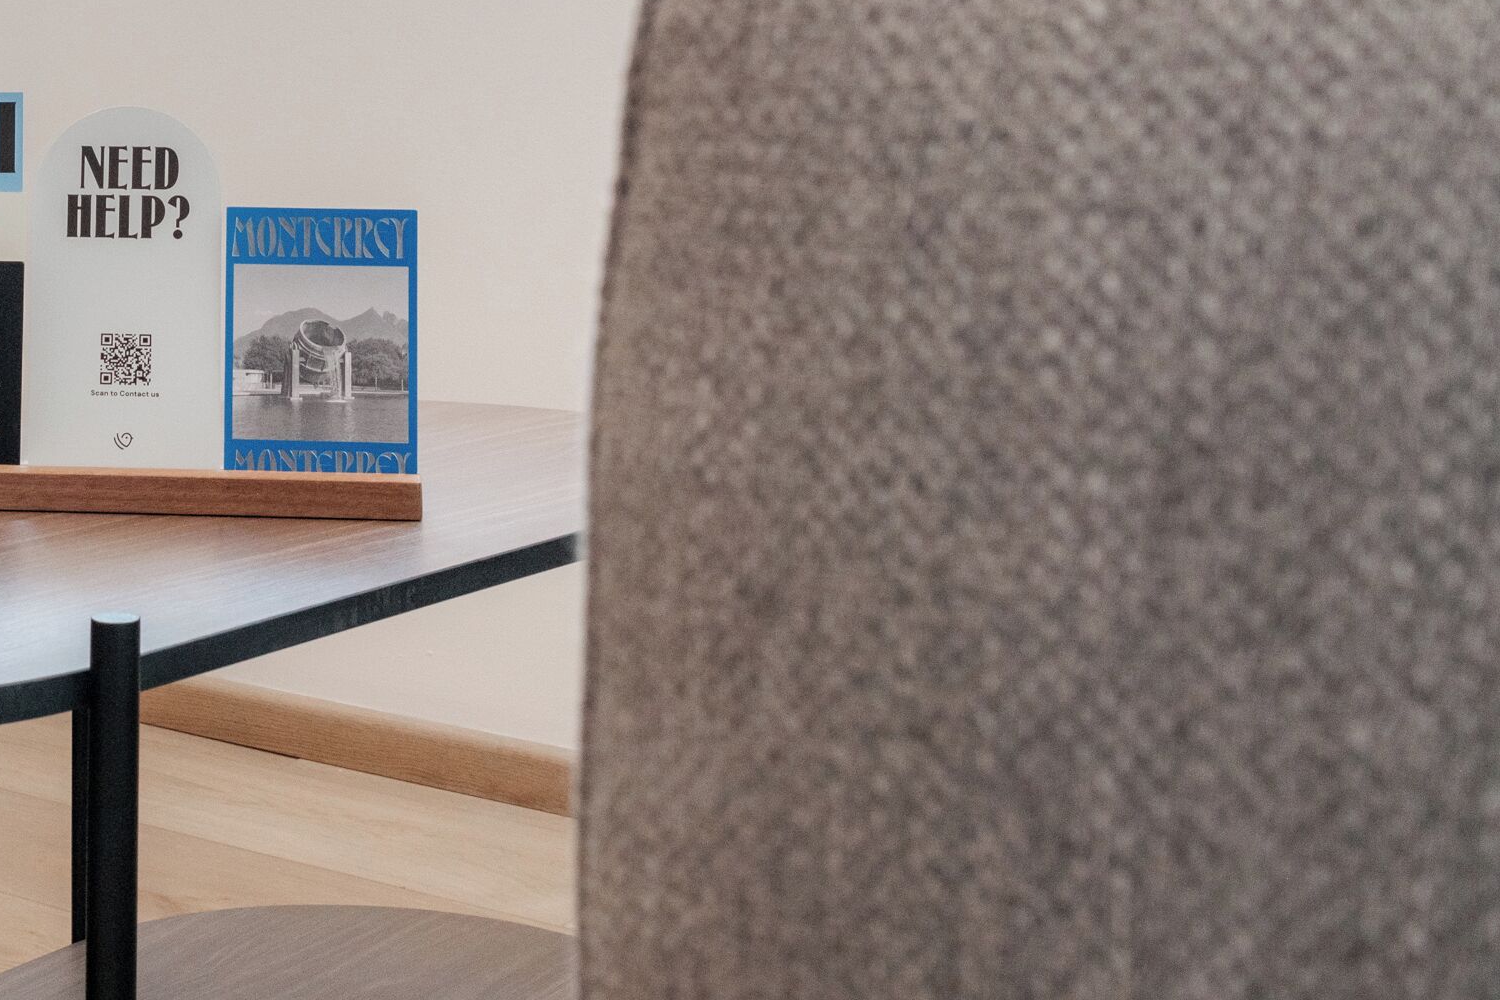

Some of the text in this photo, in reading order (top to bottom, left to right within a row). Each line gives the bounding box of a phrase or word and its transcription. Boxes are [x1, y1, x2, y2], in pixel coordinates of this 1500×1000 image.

[80, 146, 179, 190] NEED
[67, 194, 190, 240] HELP?
[231, 216, 408, 259] MONTERREY
[119, 390, 150, 398] Contact
